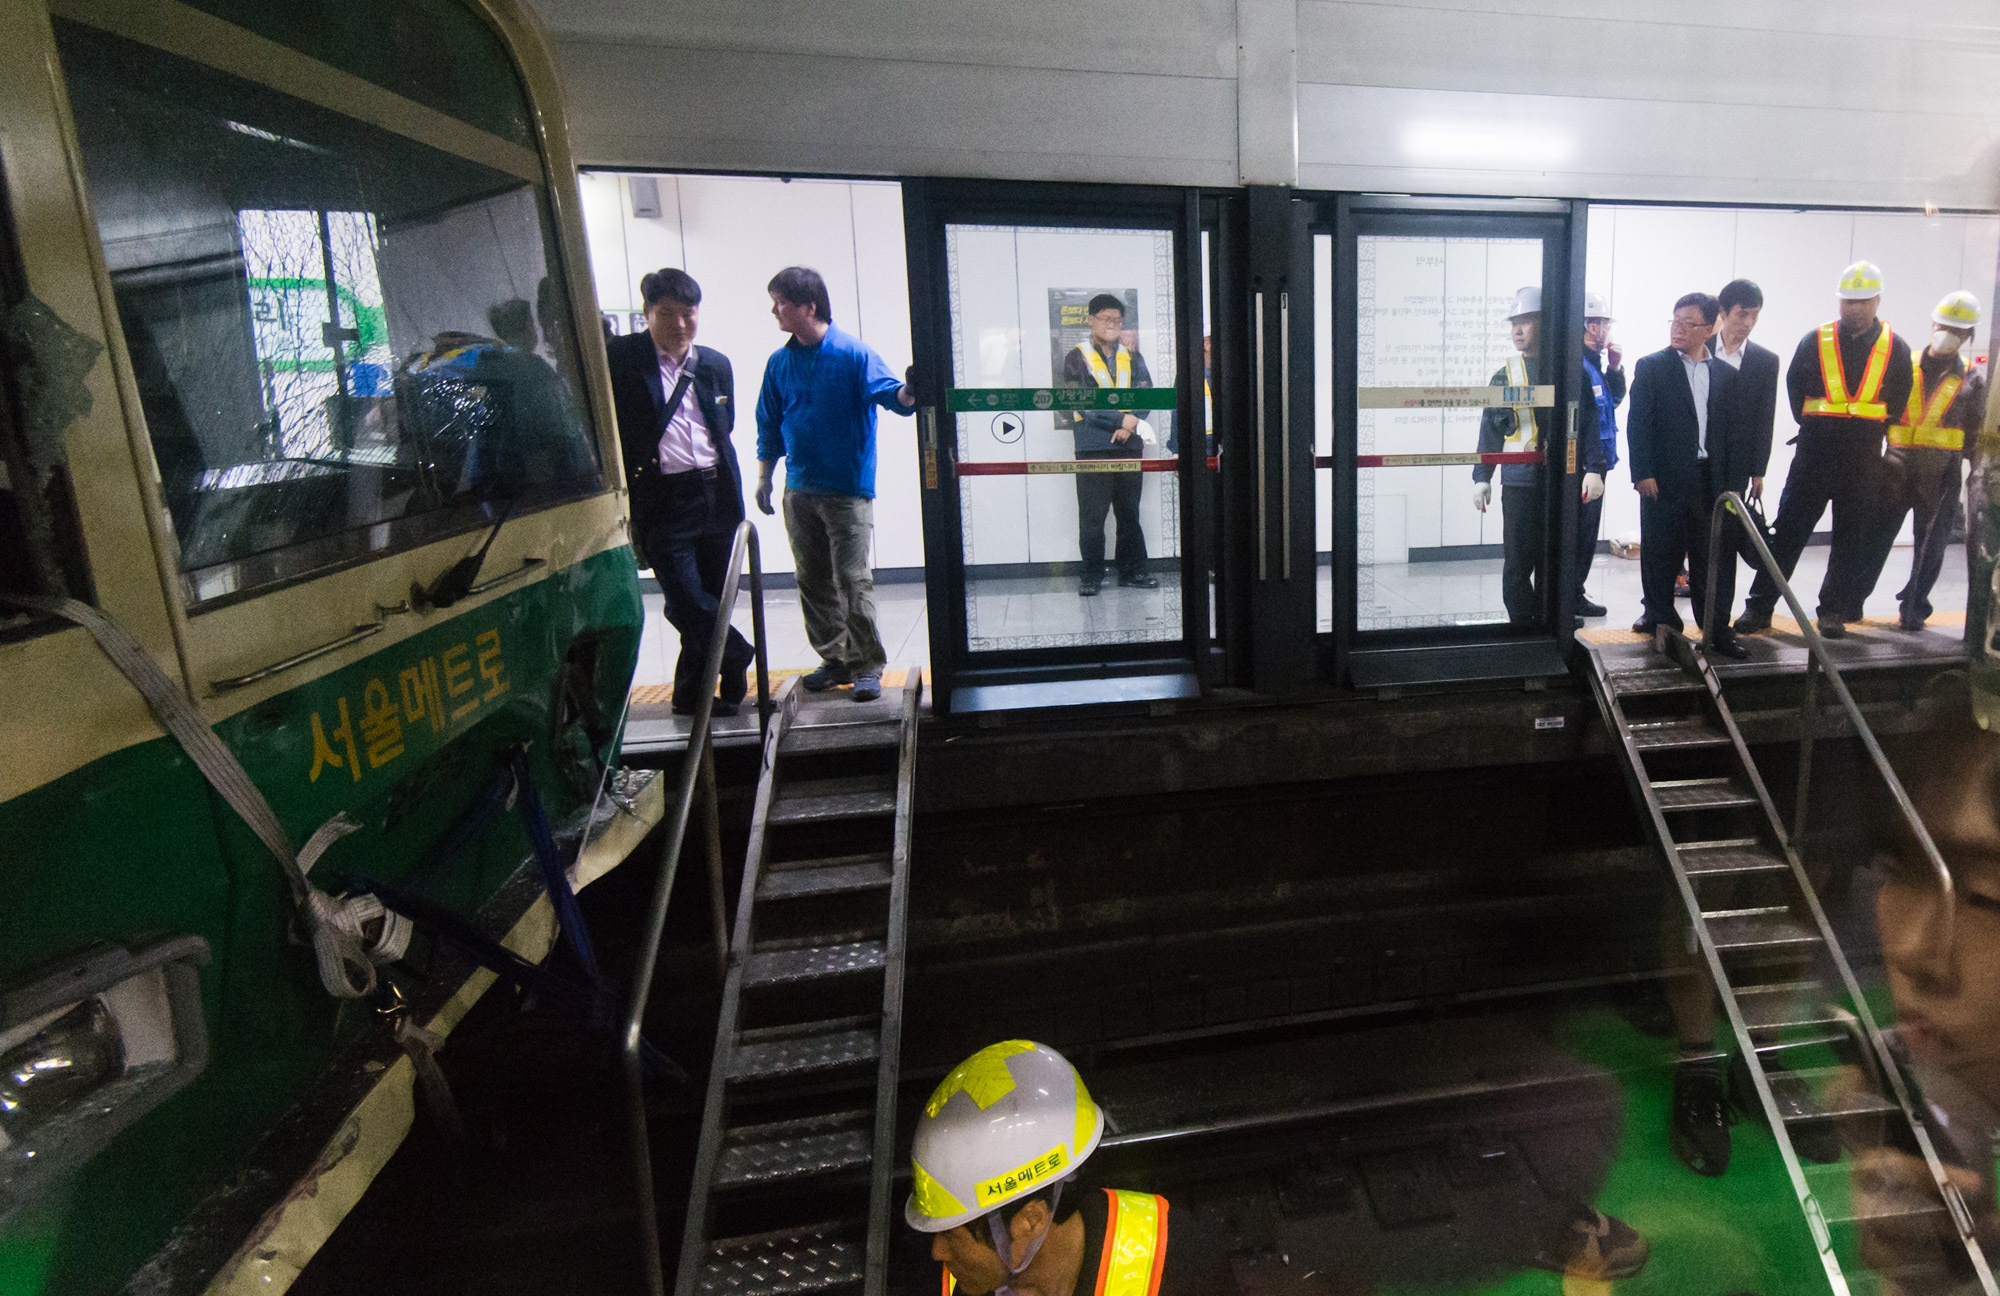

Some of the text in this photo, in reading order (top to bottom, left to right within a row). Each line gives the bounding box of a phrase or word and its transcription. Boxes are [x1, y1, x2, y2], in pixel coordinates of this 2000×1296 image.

[1034, 394, 1052, 405] 207
[1056, 389, 1096, 401] 상왕십리
[308, 626, 511, 783] 서울메트로
[988, 1153, 1061, 1195] 서울메트로
